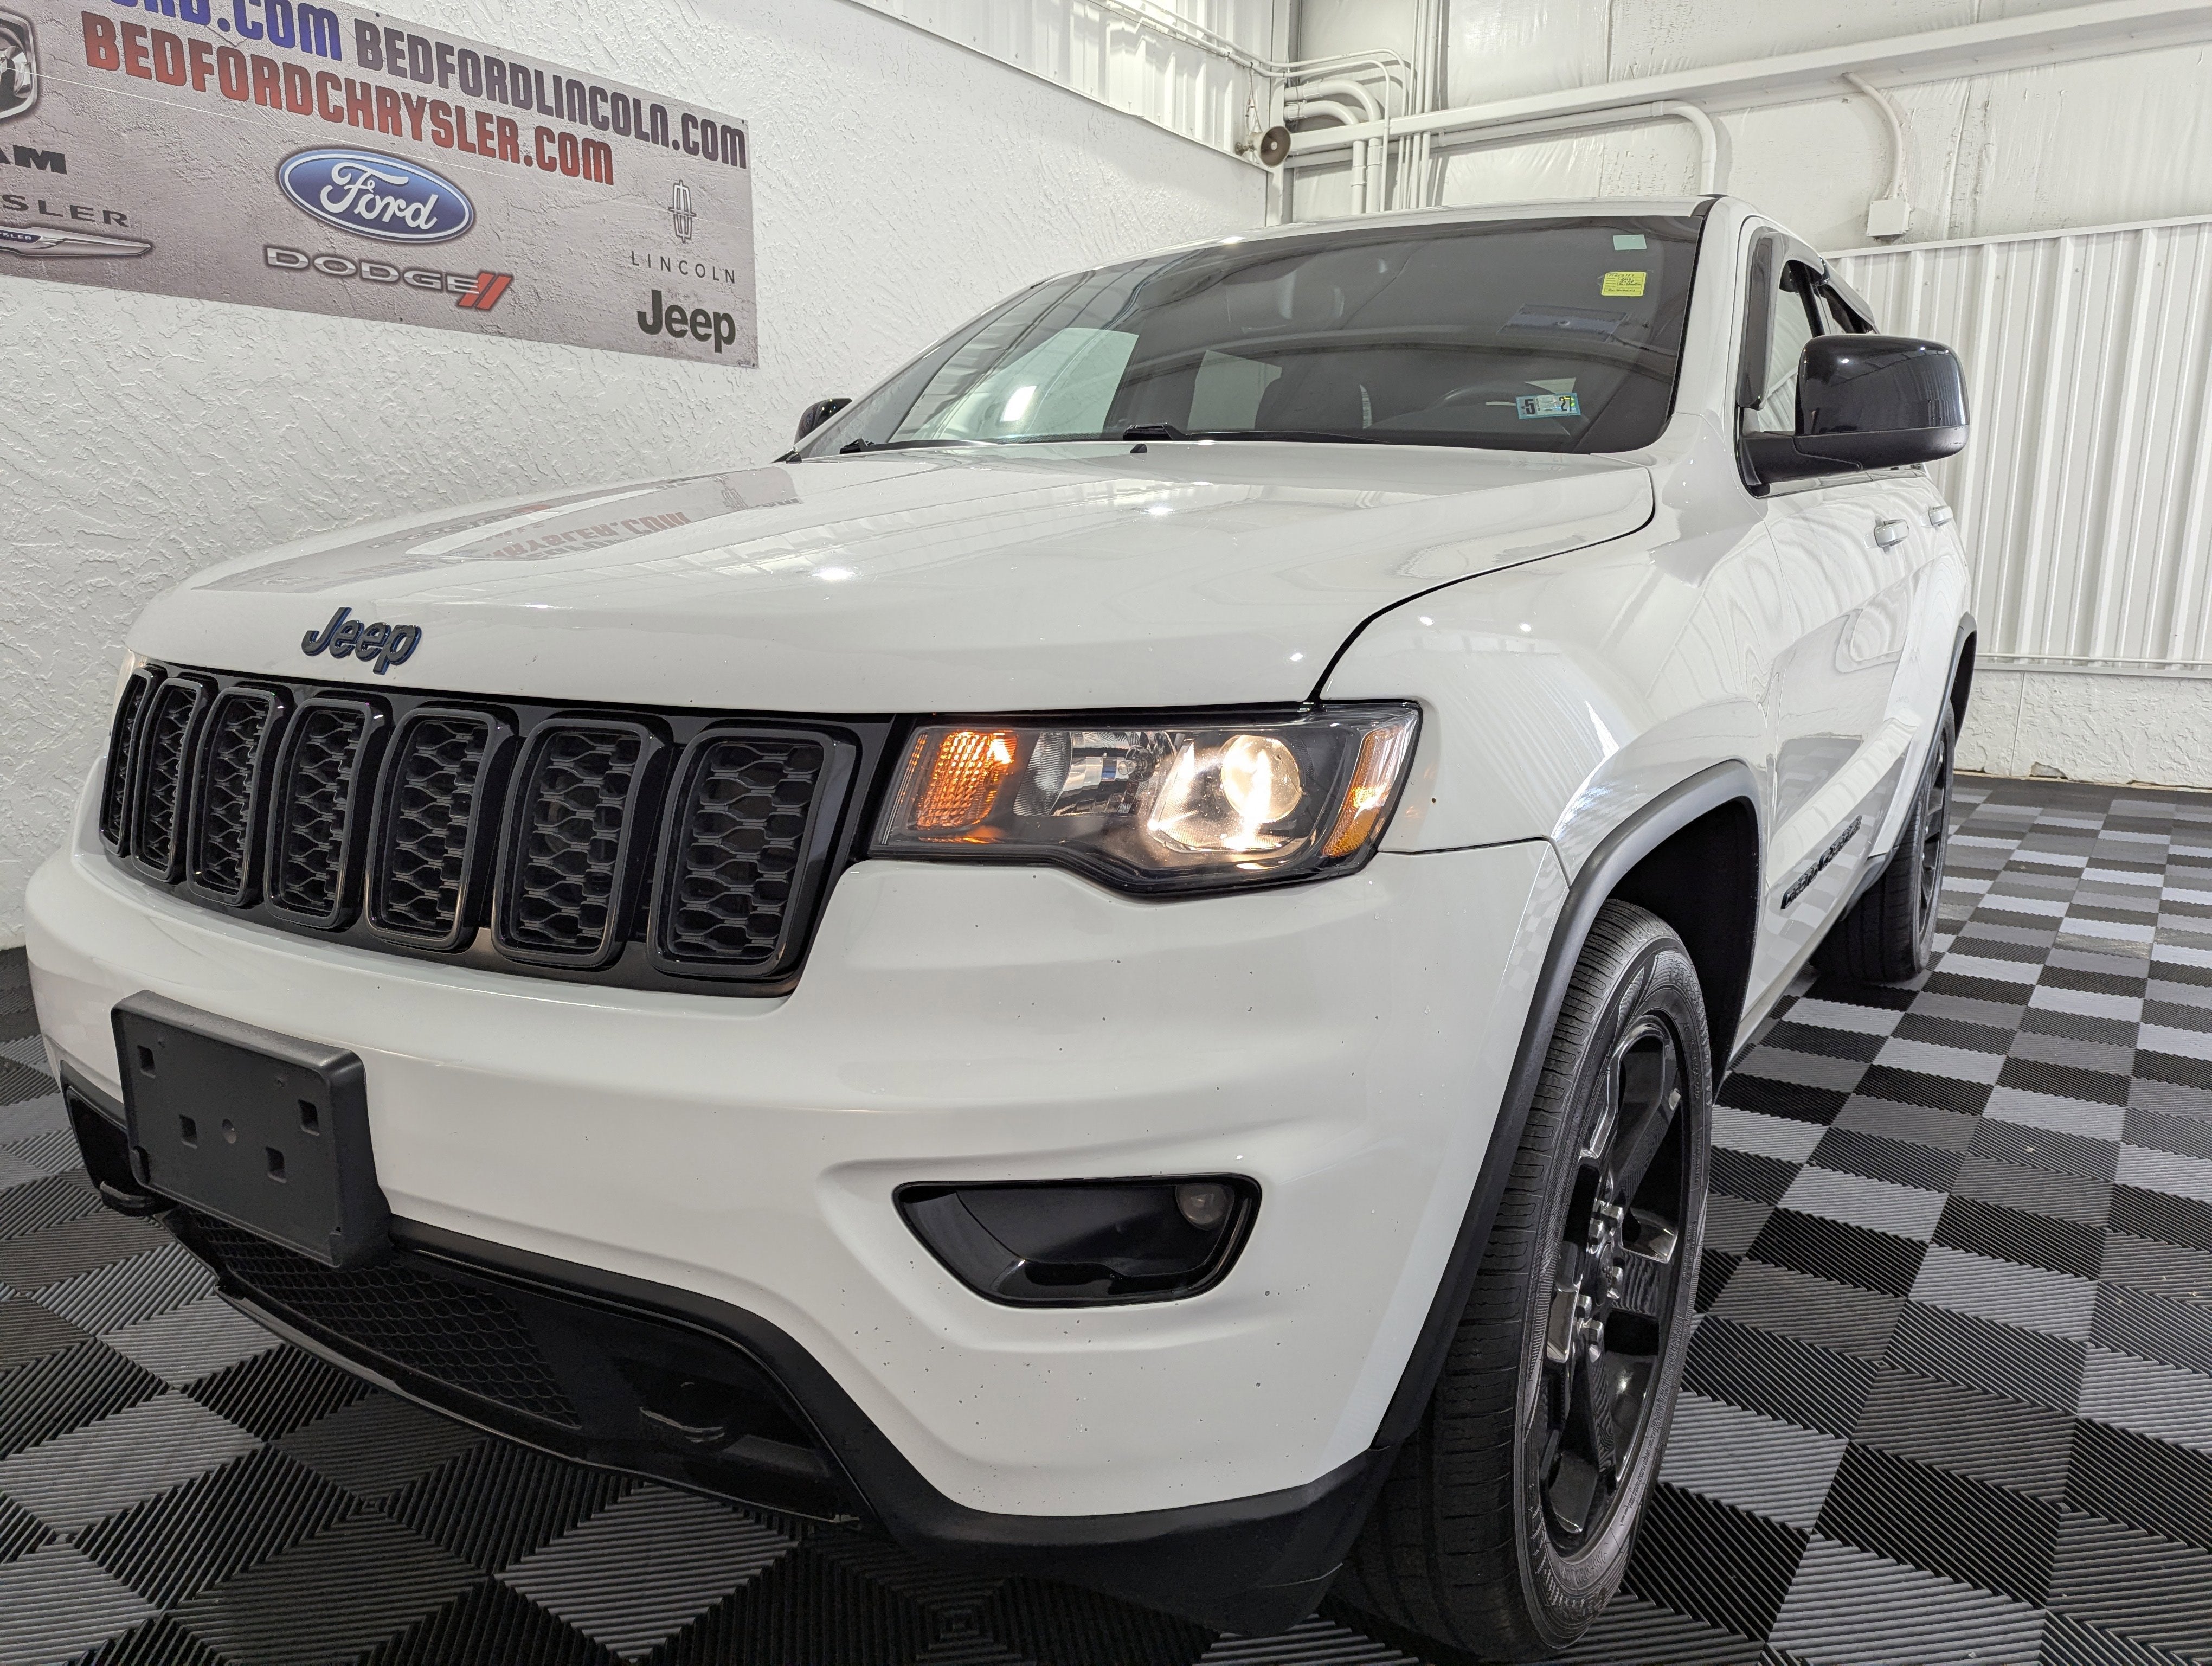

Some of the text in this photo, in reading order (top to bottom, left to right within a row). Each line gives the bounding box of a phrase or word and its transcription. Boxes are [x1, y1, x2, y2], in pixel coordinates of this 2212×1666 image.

[81, 11, 614, 185] BEDFORDCHRYSLER.COM
[353, 18, 747, 170] BEDFORDLINCOLN.COM
[0, 144, 67, 175] M
[320, 162, 439, 230] Ford
[0, 232, 33, 241] SLER
[266, 247, 480, 295] DODGE
[632, 251, 735, 284] LINCOLN
[636, 289, 736, 354] Jeep
[1524, 398, 1536, 415] 5
[301, 607, 422, 676] Jeep
